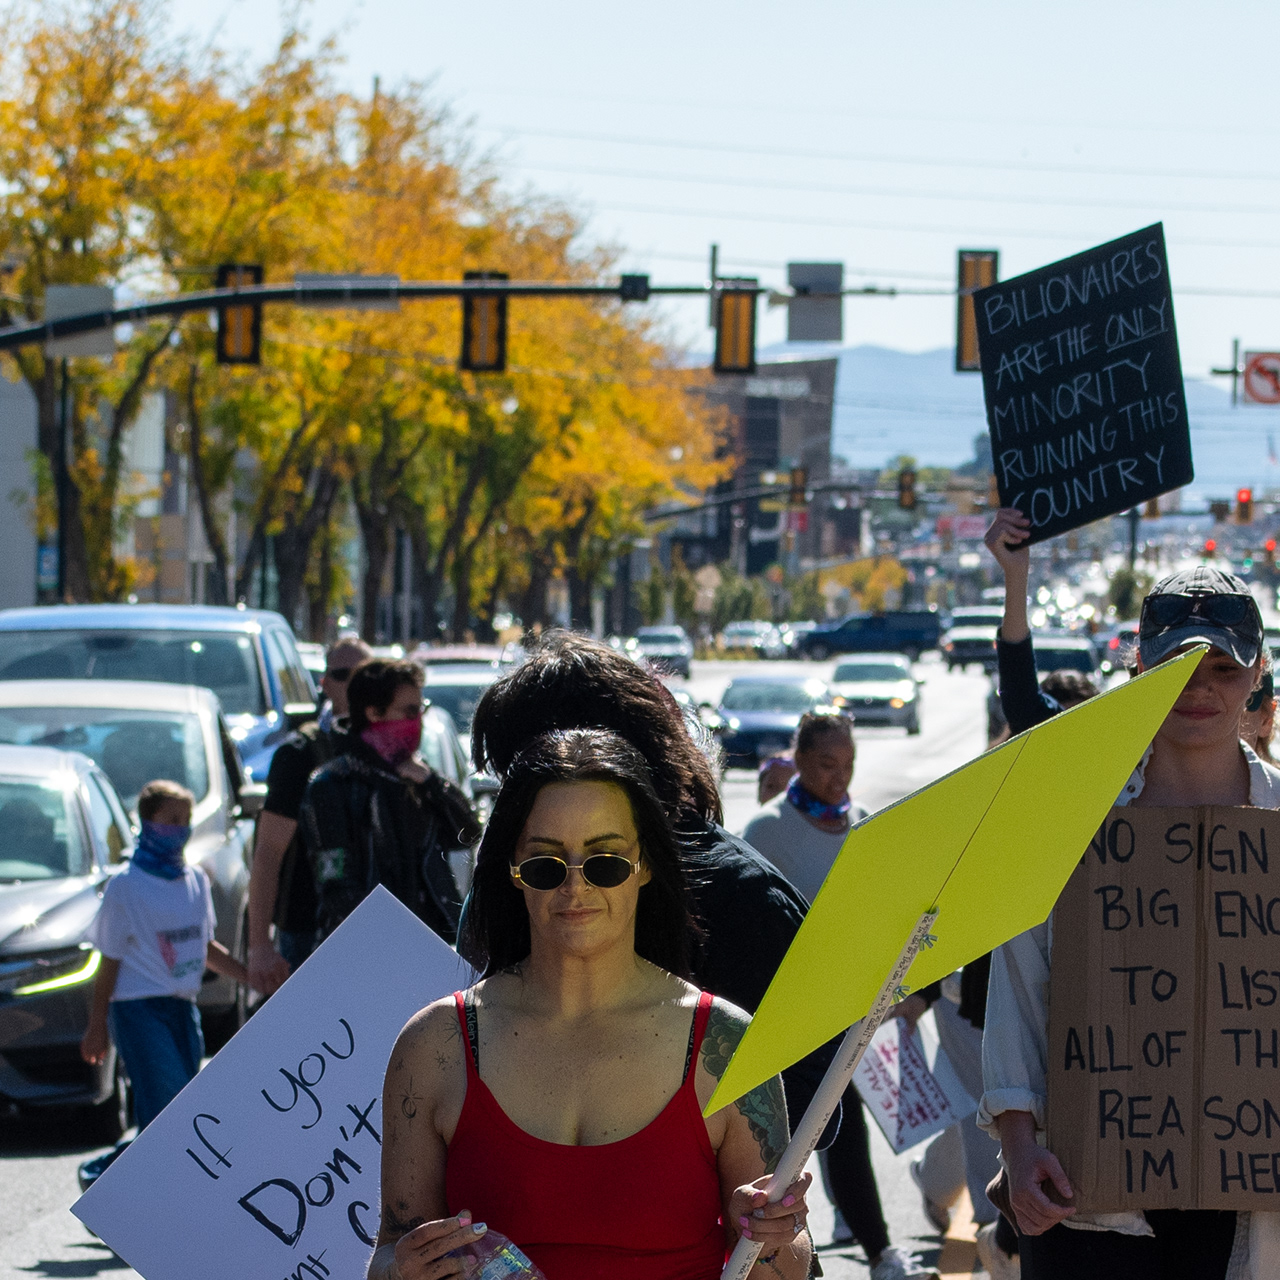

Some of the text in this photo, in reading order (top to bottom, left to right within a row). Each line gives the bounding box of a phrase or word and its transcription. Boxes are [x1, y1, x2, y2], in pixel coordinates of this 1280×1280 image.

[995, 297, 1168, 390] ARE THE ONLY
[994, 352, 1151, 441] MINORITY
[1000, 392, 1178, 489] RUINING THIS
[1165, 822, 1268, 874] SIGN
[1094, 885, 1179, 931] BIG
[1110, 965, 1177, 1005] TO
[1064, 1025, 1133, 1073] ALL
[1142, 1030, 1187, 1068] OF
[238, 1097, 382, 1249] Don't
[1125, 1148, 1179, 1194] IM
